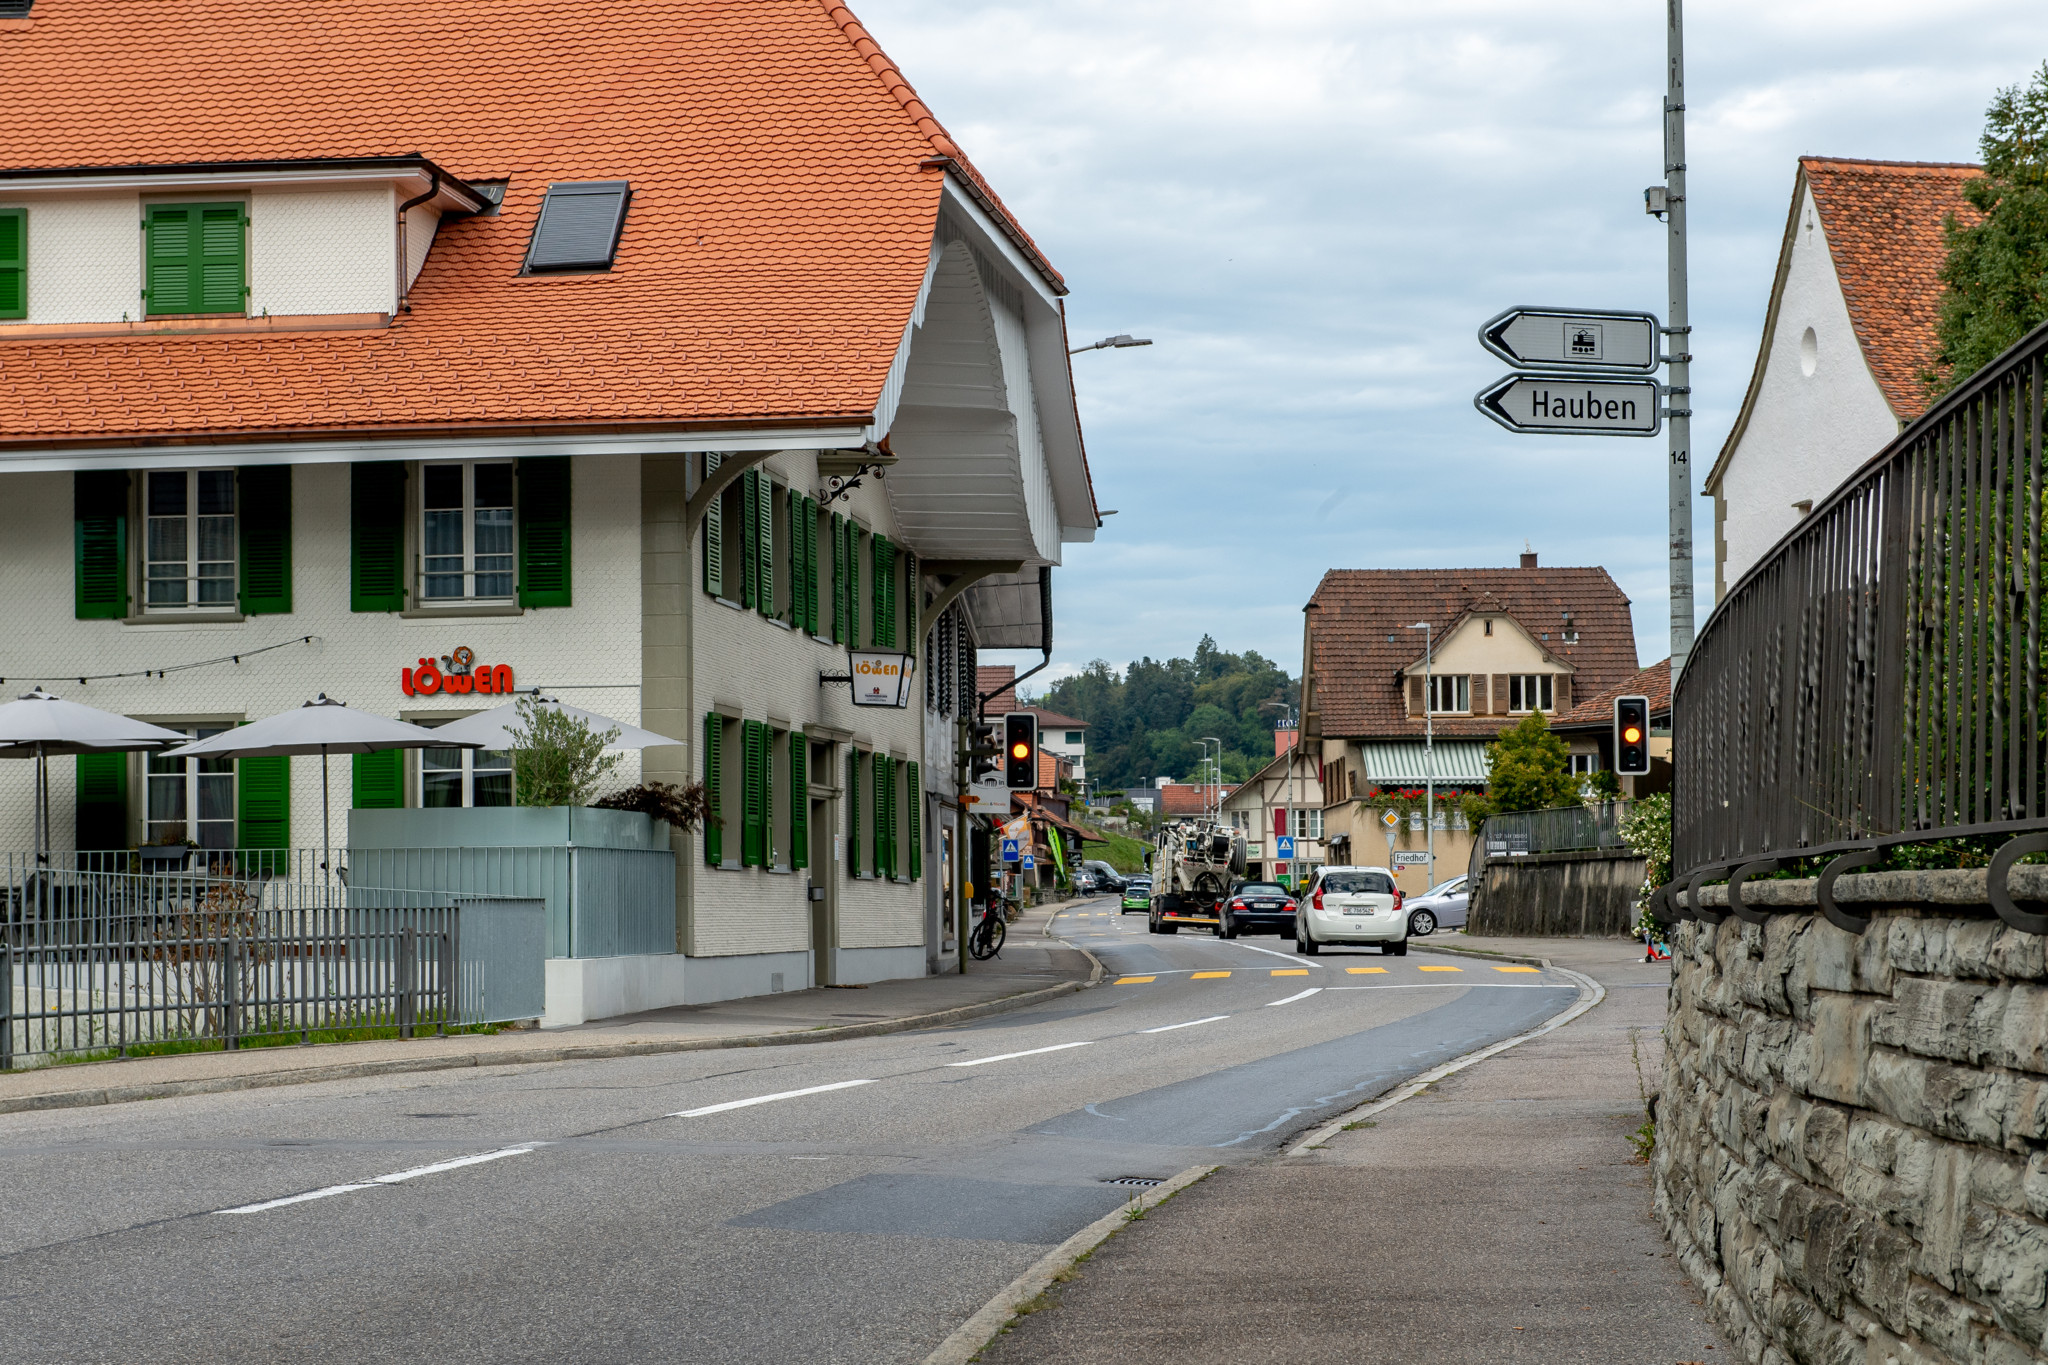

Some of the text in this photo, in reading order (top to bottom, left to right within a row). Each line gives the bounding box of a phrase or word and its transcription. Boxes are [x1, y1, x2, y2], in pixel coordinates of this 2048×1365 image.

[1532, 390, 1636, 420] Hauben
[1670, 450, 1687, 465] 14
[1396, 853, 1427, 862] Friedhof
